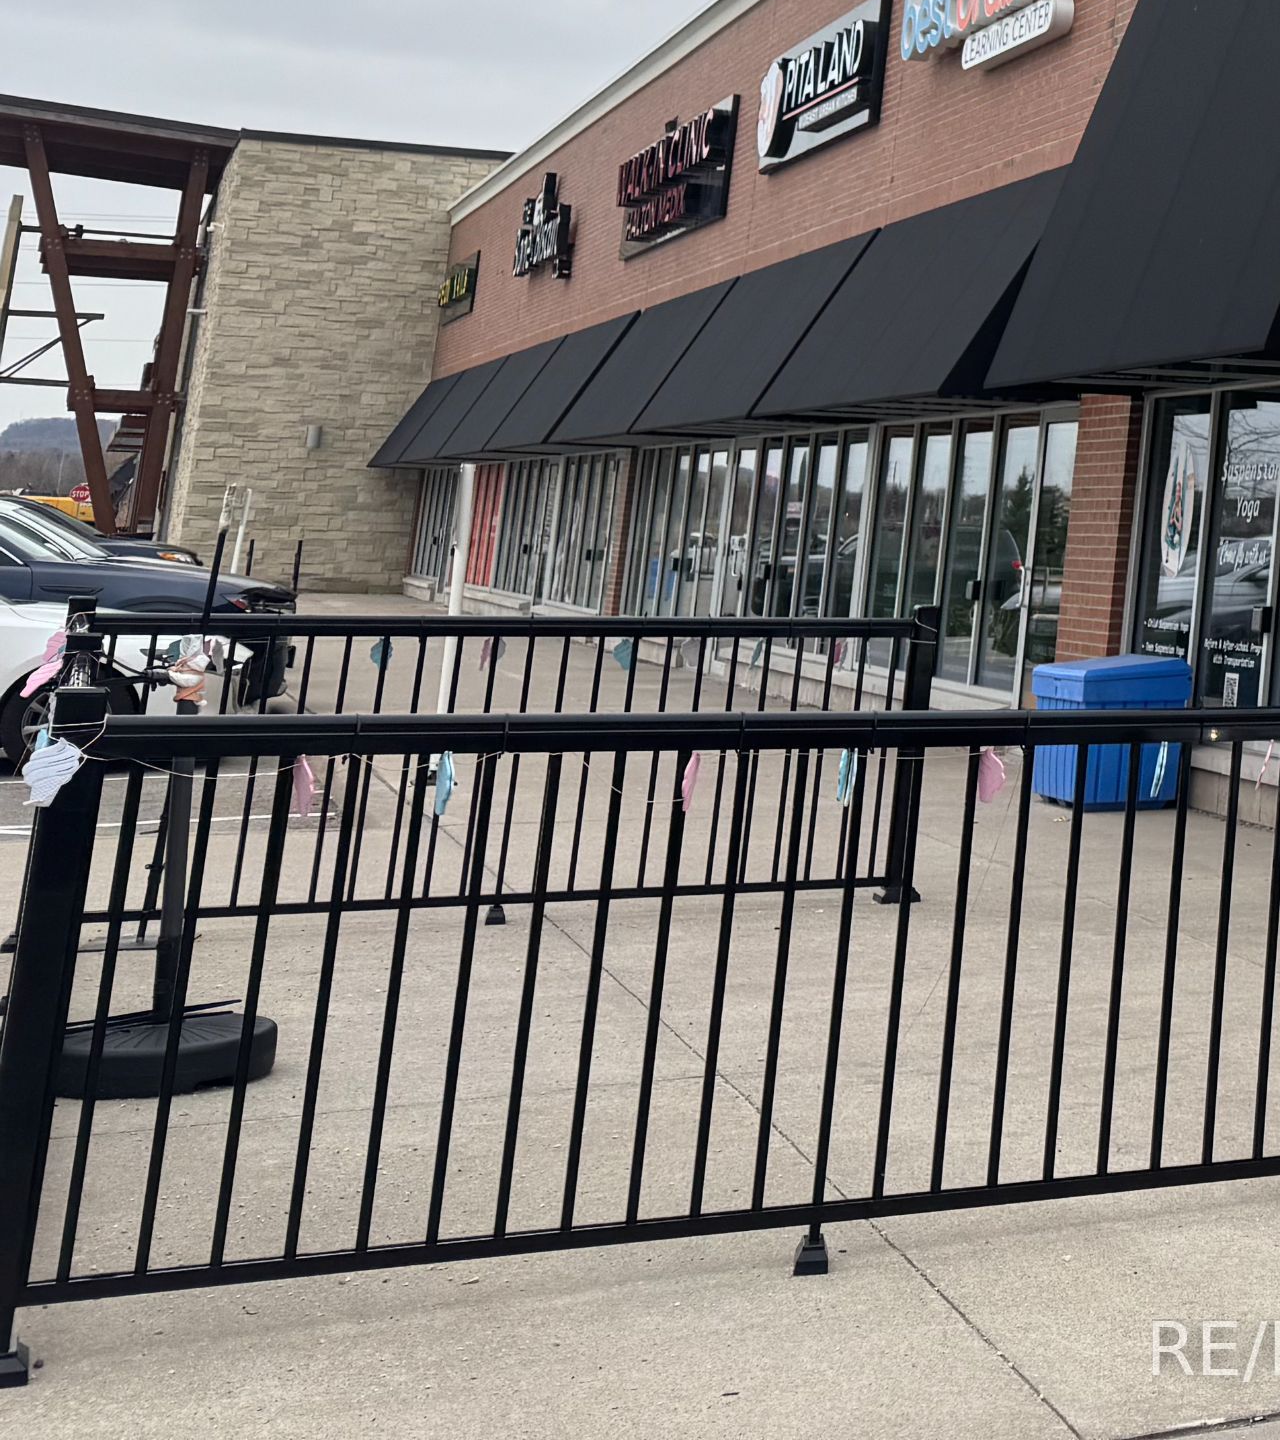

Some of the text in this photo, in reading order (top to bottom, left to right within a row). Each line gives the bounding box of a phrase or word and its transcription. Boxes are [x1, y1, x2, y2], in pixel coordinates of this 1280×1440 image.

[964, 1, 1051, 64] LEARNING CENTER
[667, 107, 715, 179] CLINIC
[71, 490, 90, 498] STOP
[1236, 495, 1261, 524] Yoga
